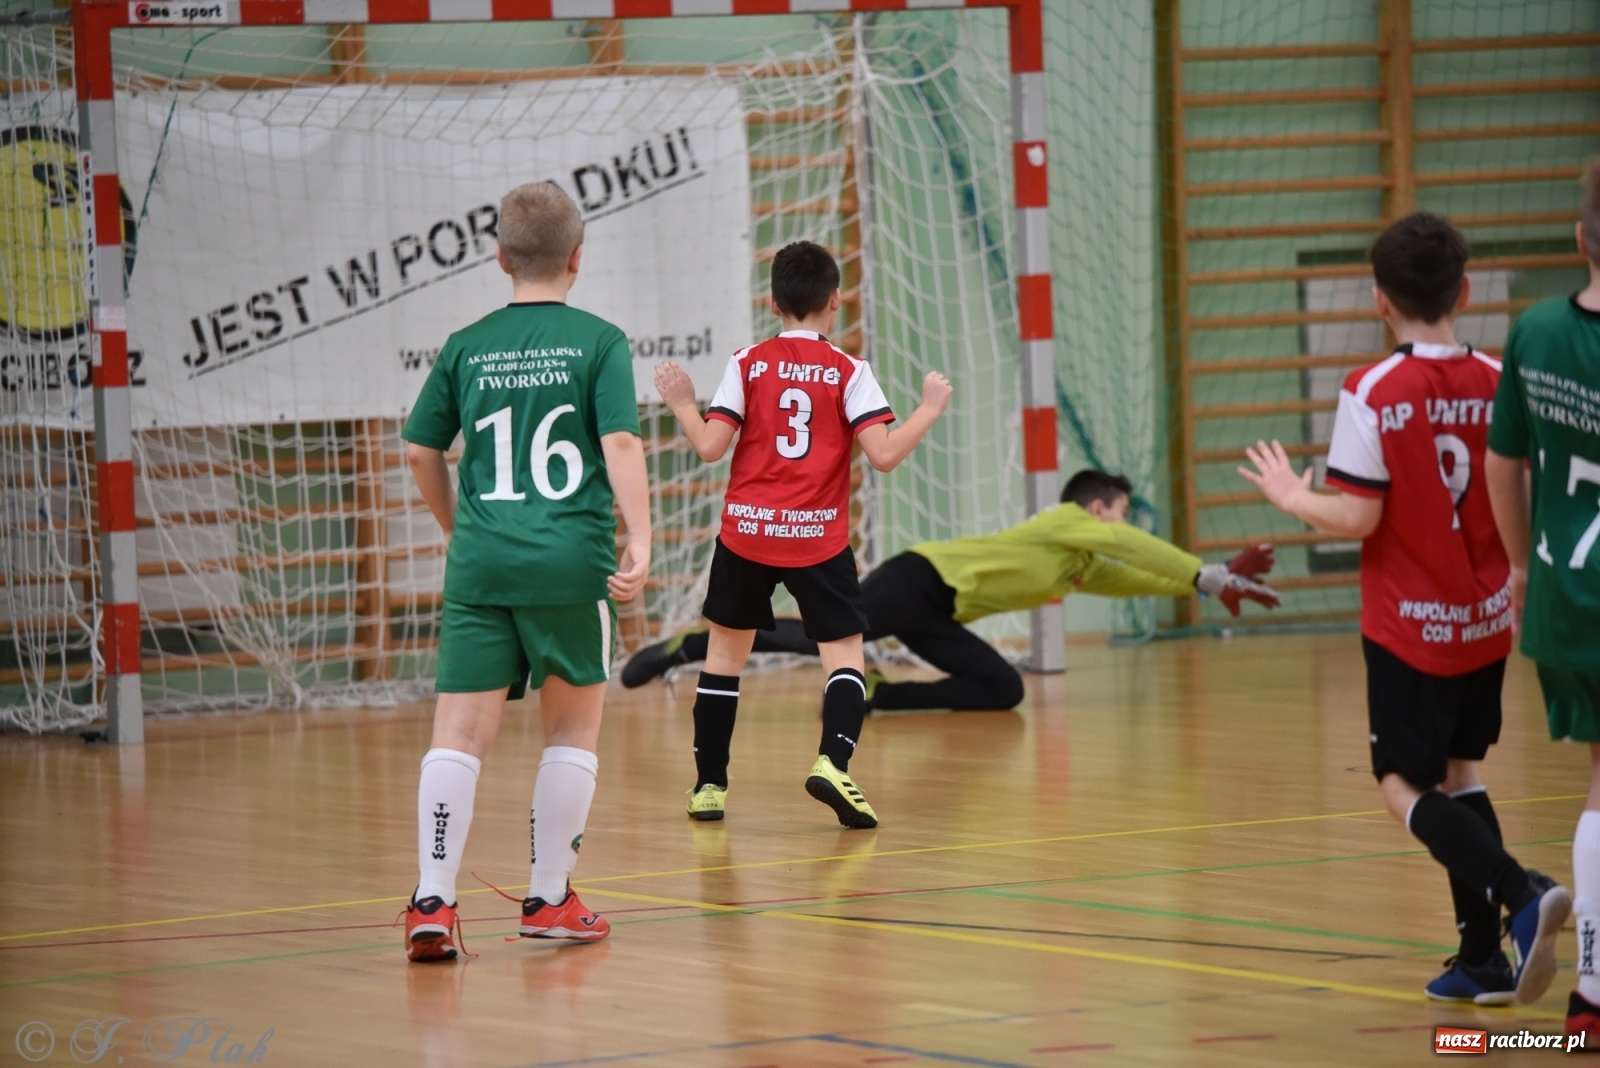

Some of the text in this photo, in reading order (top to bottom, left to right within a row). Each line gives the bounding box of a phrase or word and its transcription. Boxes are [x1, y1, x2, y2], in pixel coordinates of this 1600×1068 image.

[182, 5, 222, 20] sport
[183, 275, 310, 368] JEST
[326, 250, 381, 309] W
[467, 350, 522, 365] AKADEMIA
[477, 367, 571, 391] TWORKÓW
[775, 387, 812, 460] 3
[1381, 401, 1413, 434] AP
[475, 403, 583, 501] 16
[1434, 432, 1472, 531] 9
[764, 524, 825, 538] WIELKIEGO
